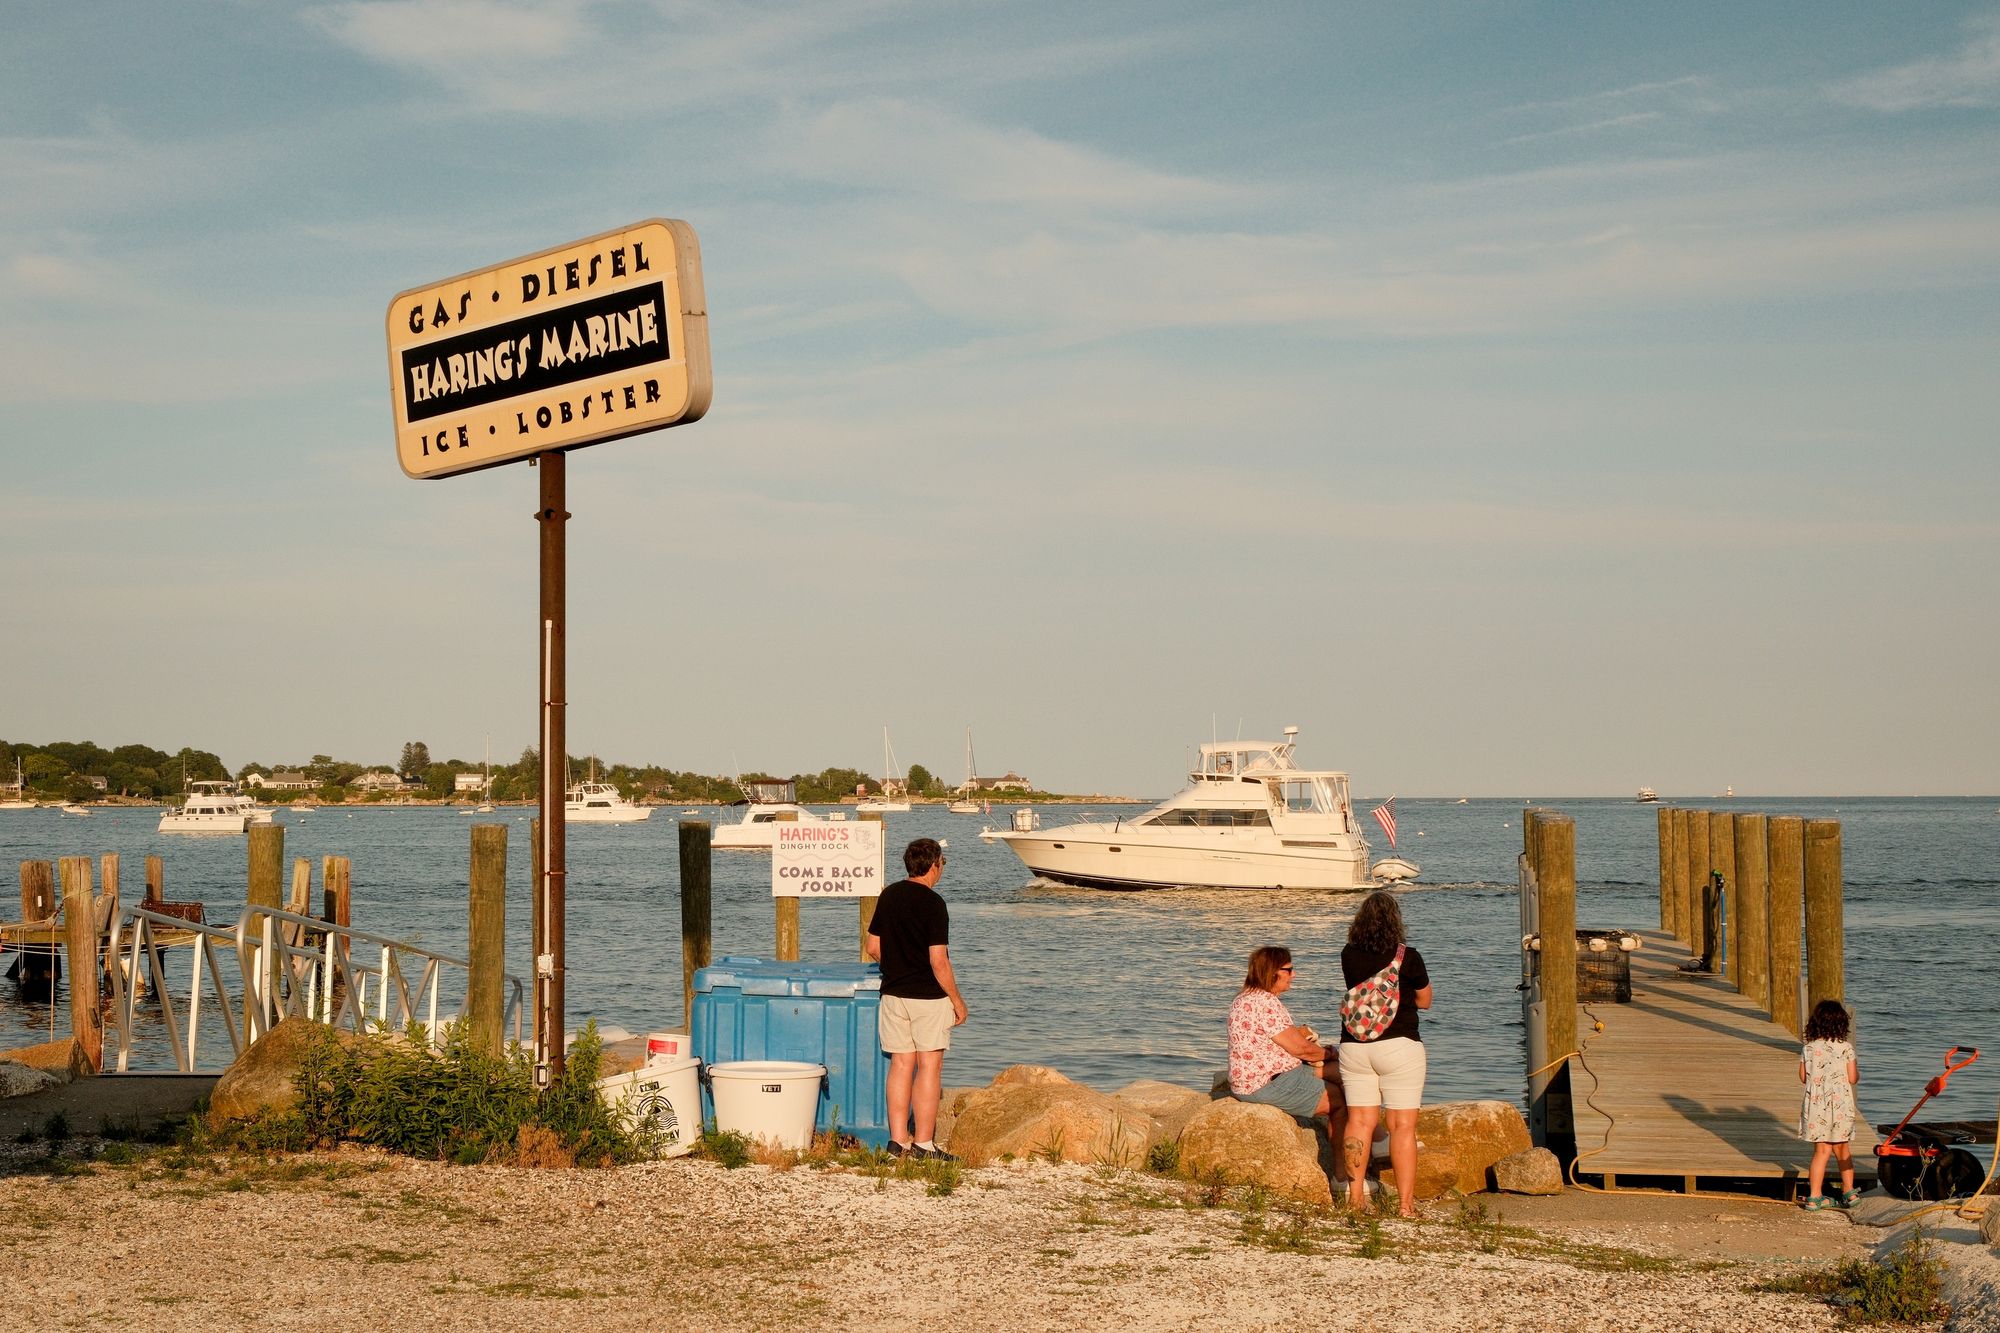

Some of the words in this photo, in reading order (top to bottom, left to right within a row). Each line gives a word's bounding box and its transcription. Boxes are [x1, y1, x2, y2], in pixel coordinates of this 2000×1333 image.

[409, 290, 471, 333] GAS
[521, 241, 650, 303] DIESEL
[410, 334, 531, 403] HARING'S
[538, 300, 659, 370] MARINE
[421, 424, 470, 456] ICE
[517, 379, 661, 434] LOBSTER
[780, 827, 849, 841] HARING'S
[779, 867, 824, 878] COME
[832, 867, 874, 878] BACK
[801, 881, 853, 892] SOON!
